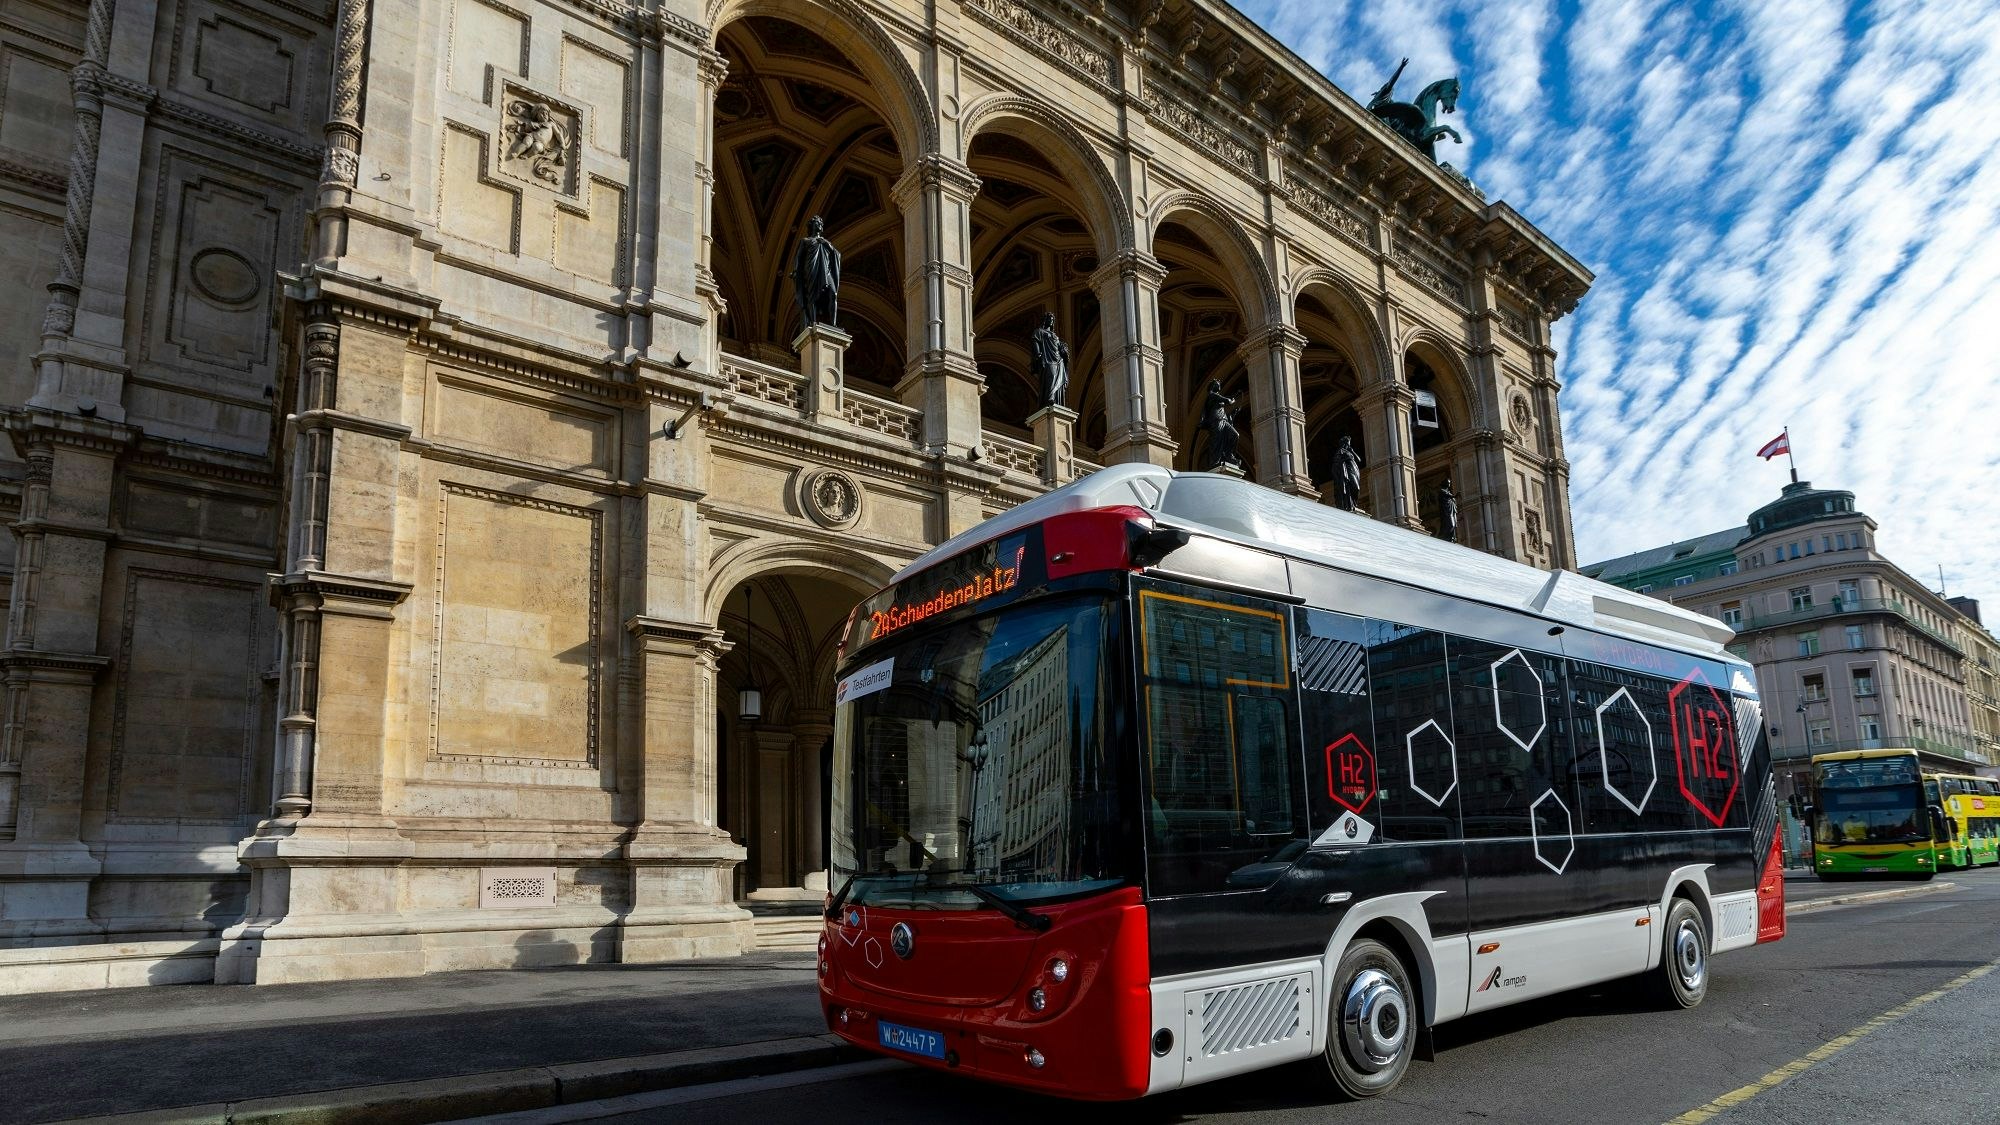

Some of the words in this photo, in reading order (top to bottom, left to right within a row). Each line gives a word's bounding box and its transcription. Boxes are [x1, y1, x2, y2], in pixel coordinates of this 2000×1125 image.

[890, 567, 1015, 630] Schwedenplatz
[852, 669, 891, 692] Testfahrten
[1684, 703, 1728, 779] H2
[1340, 752, 1365, 784] H2
[899, 1030, 925, 1051] 2447
[928, 1035, 936, 1052] P
